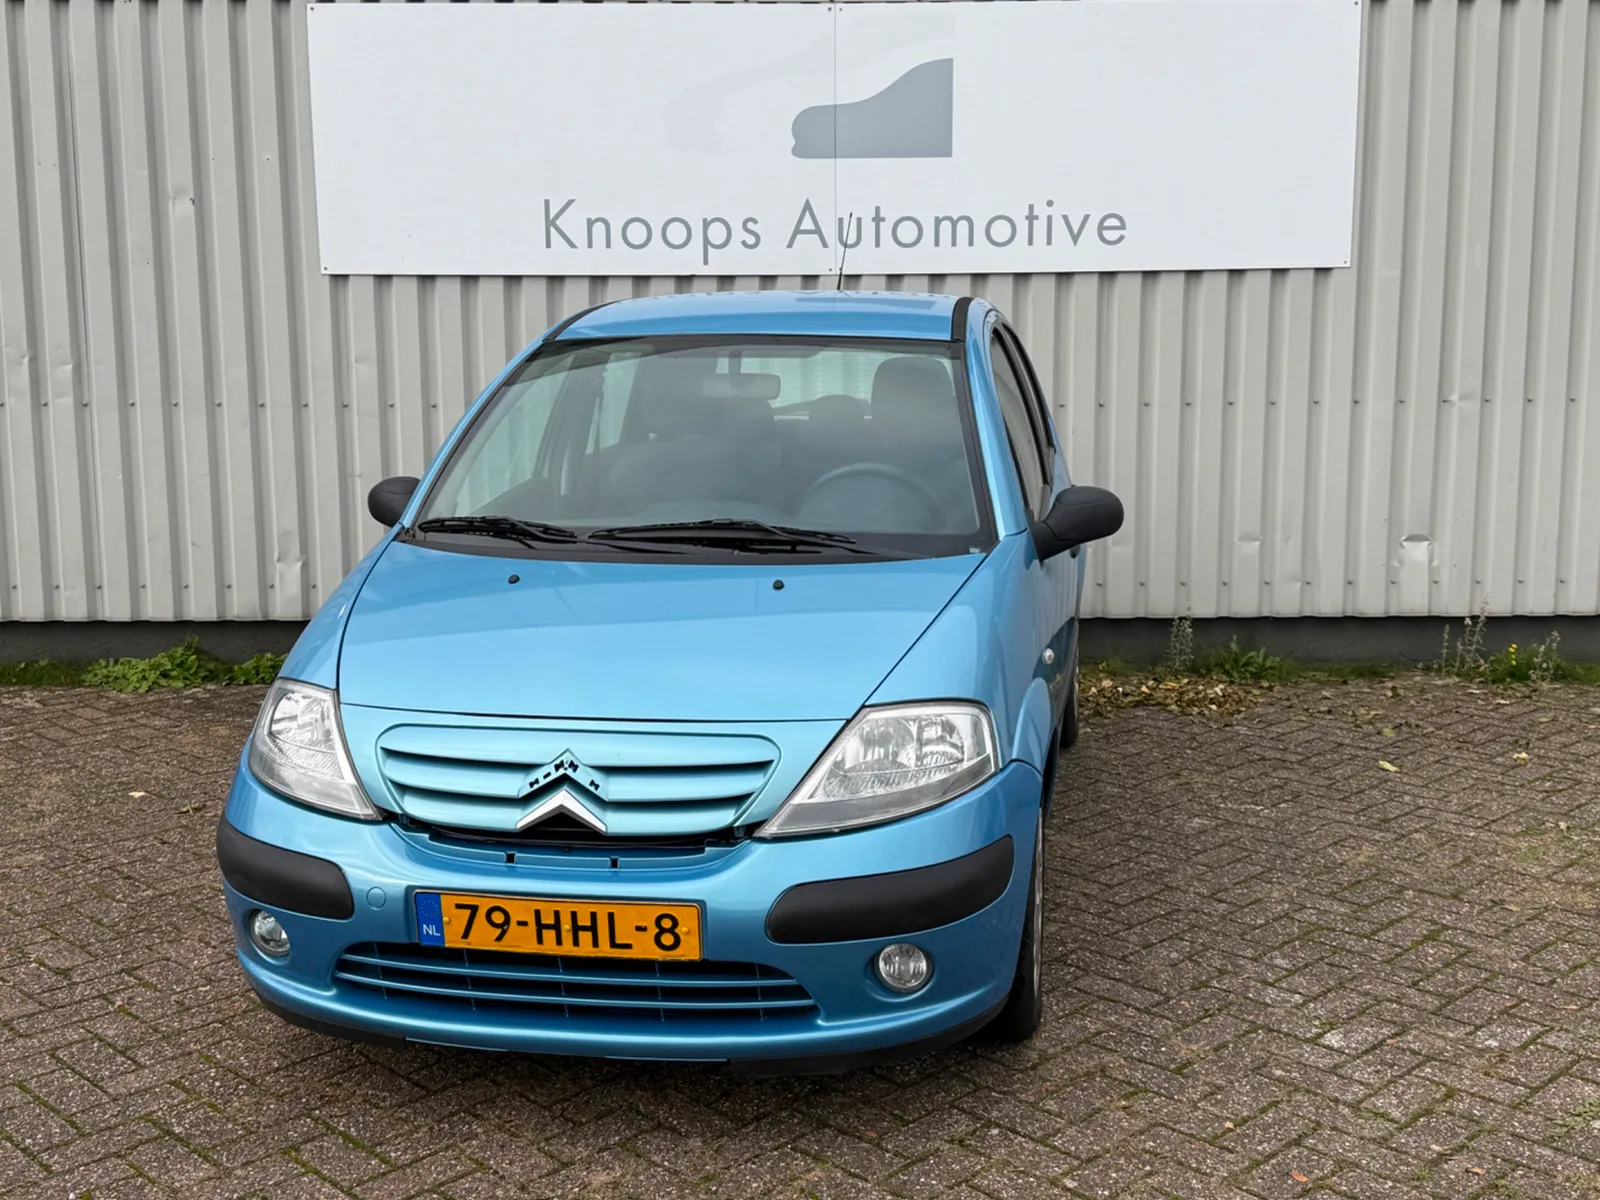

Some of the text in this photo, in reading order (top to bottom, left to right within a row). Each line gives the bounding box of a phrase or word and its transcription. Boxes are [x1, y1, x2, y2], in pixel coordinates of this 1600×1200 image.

[543, 197, 1128, 266] Knoops Automotive
[422, 923, 441, 937] NL
[454, 902, 682, 952] 79-HHL-8
